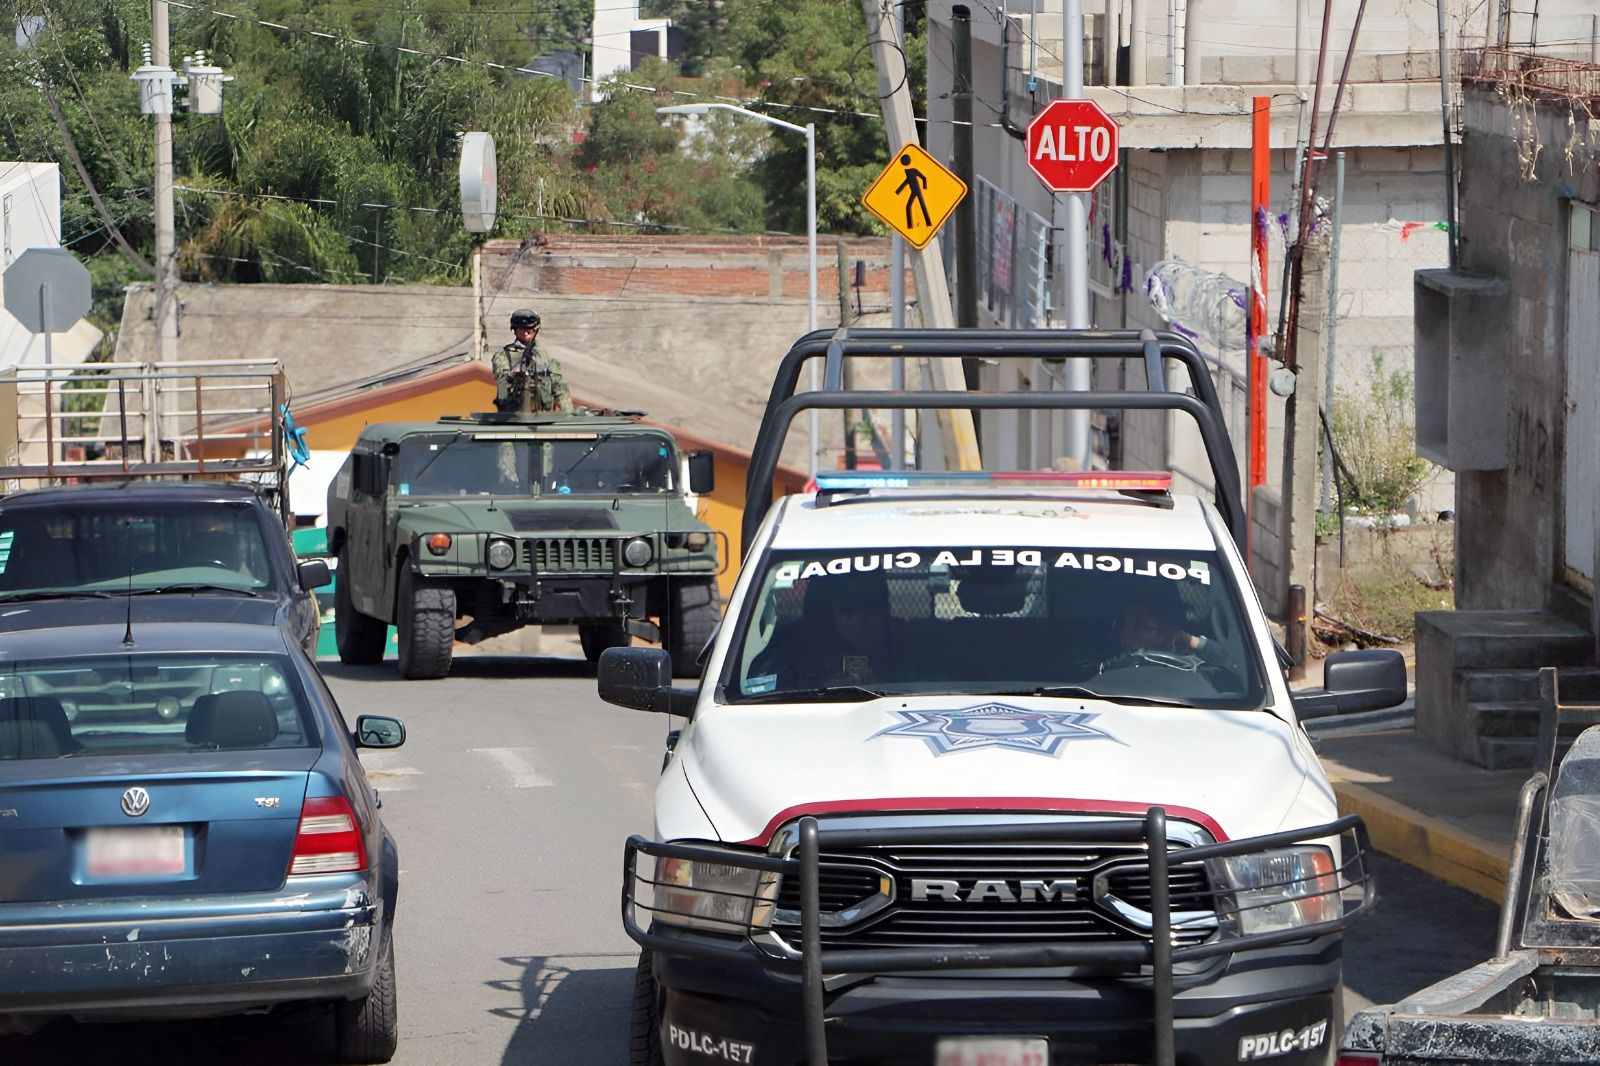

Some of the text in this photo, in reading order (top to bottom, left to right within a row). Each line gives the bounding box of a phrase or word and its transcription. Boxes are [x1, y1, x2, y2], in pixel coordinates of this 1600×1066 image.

[1034, 124, 1111, 162] ALTO
[911, 878, 1078, 903] RAM
[669, 1023, 753, 1064] PDLC-157
[1240, 1020, 1328, 1059] PDLC-157
